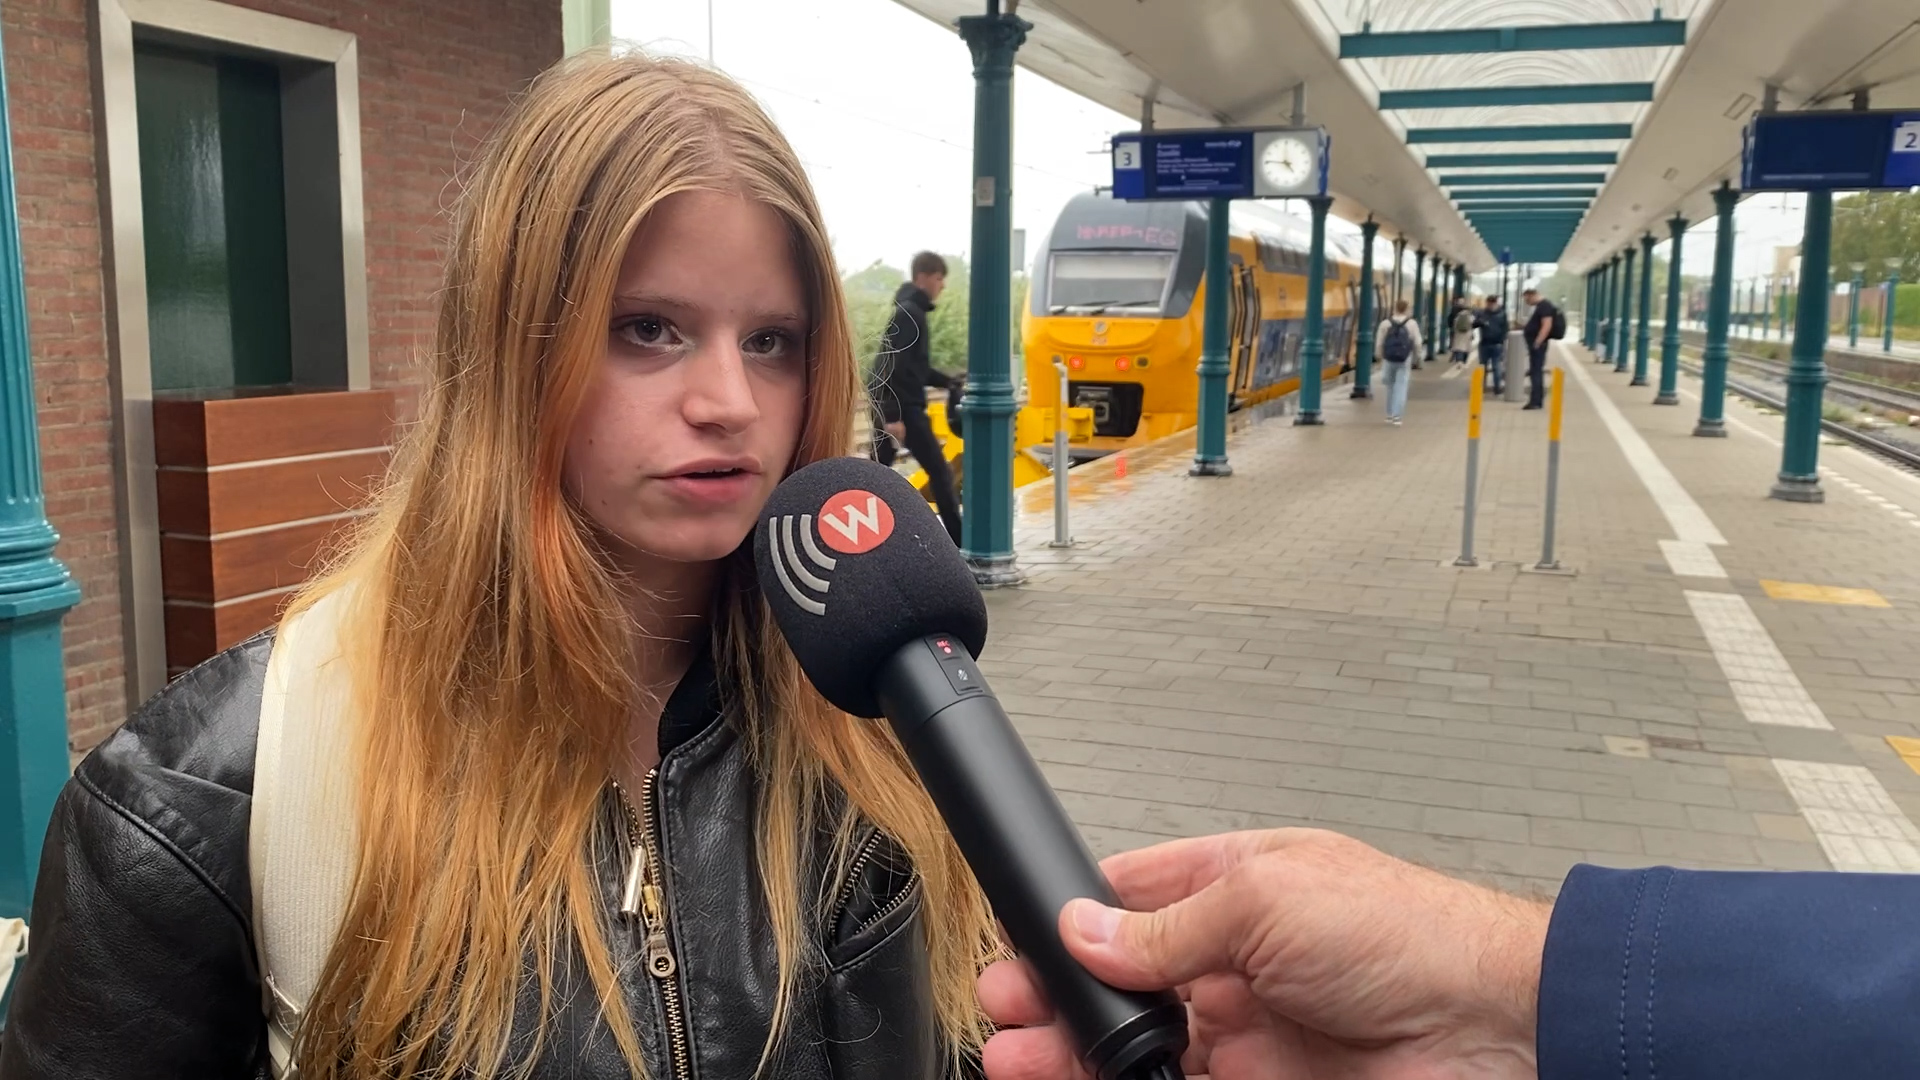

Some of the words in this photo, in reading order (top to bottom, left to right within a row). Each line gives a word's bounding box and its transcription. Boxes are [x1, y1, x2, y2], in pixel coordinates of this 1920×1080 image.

[1904, 132, 1917, 148] 2
[1123, 152, 1132, 166] 3
[822, 496, 880, 545] W
